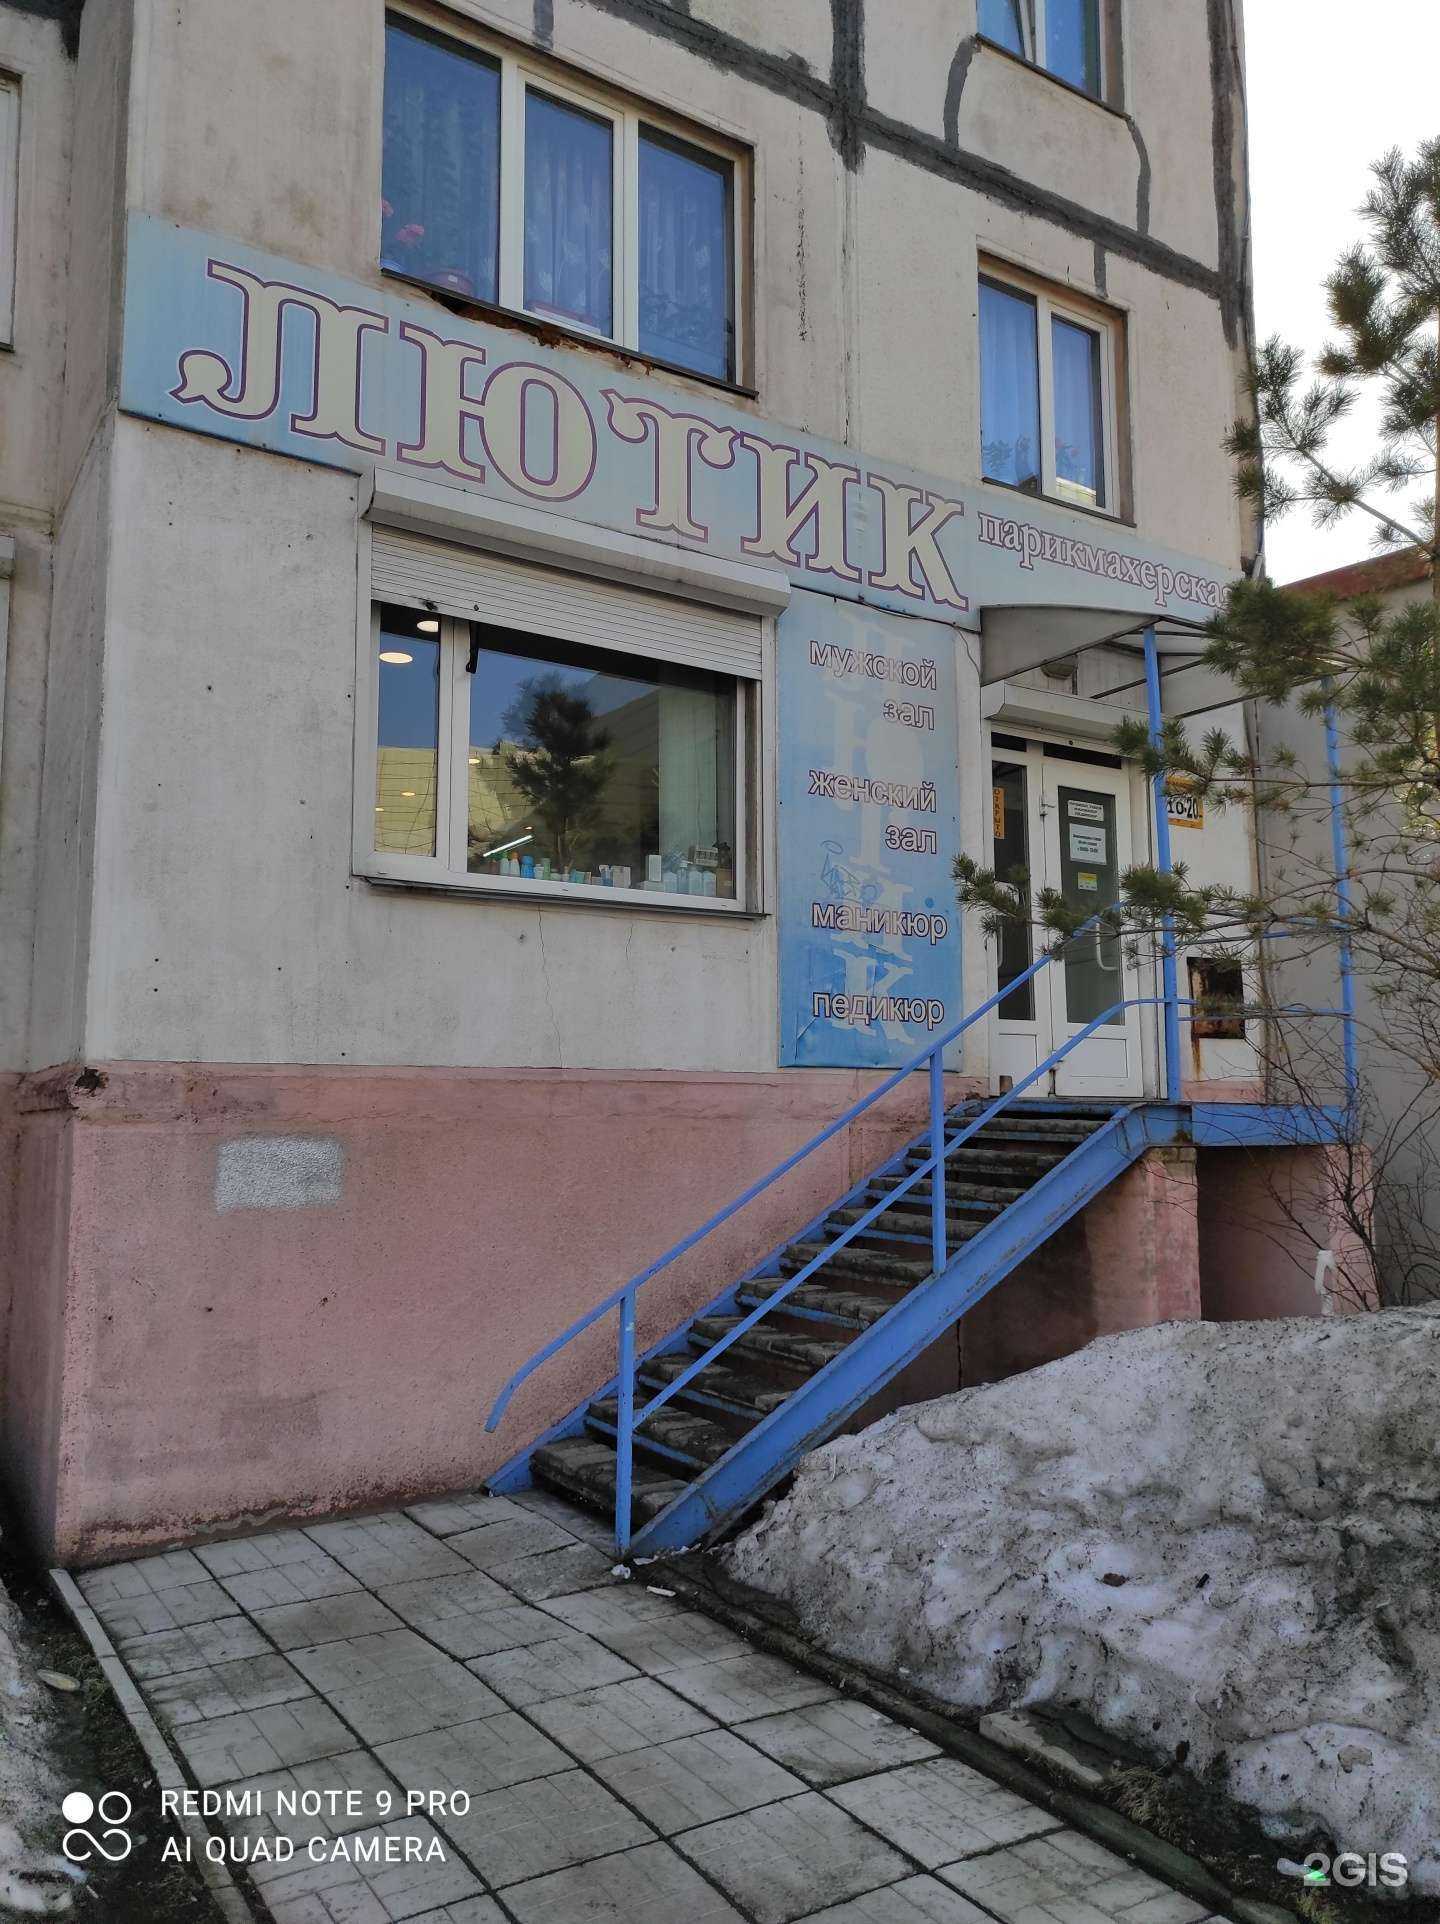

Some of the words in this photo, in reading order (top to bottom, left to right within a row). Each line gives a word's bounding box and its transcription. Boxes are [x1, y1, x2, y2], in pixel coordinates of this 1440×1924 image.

[169, 257, 969, 611] ЛЮТИК
[808, 639, 938, 691] мужской
[883, 699, 935, 731] зал
[807, 768, 937, 813] женский
[884, 824, 937, 854] зал
[811, 902, 948, 945] маникюр
[812, 991, 945, 1031] педикюр
